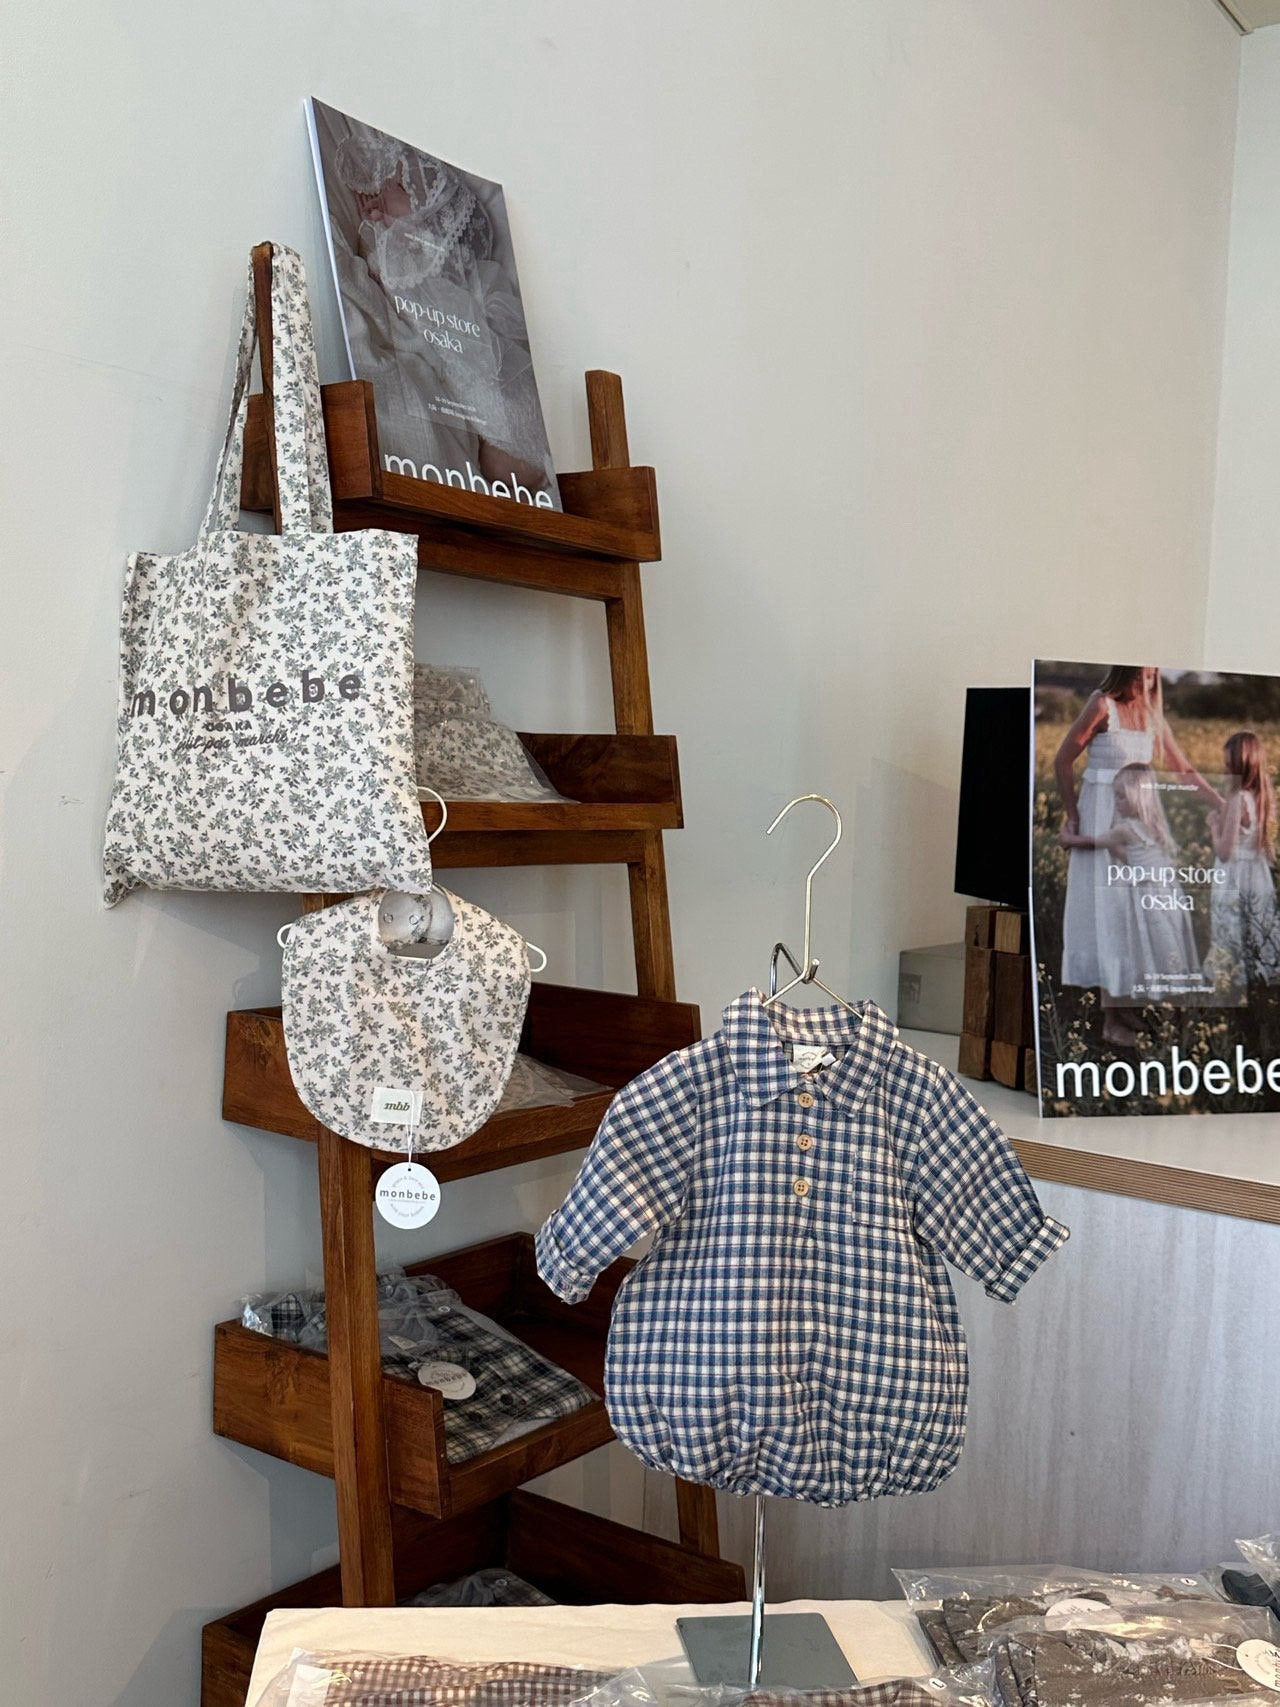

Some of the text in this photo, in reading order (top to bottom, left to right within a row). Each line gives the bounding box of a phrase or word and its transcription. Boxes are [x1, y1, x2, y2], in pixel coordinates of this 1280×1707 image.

[394, 295, 480, 338] pop-up store
[423, 329, 463, 353] osaka
[130, 669, 362, 718] monbebe
[1107, 864, 1226, 887] pop-up store
[1140, 888, 1195, 911] osaka
[383, 1101, 410, 1111] mbb
[379, 1189, 436, 1201] monbebe
